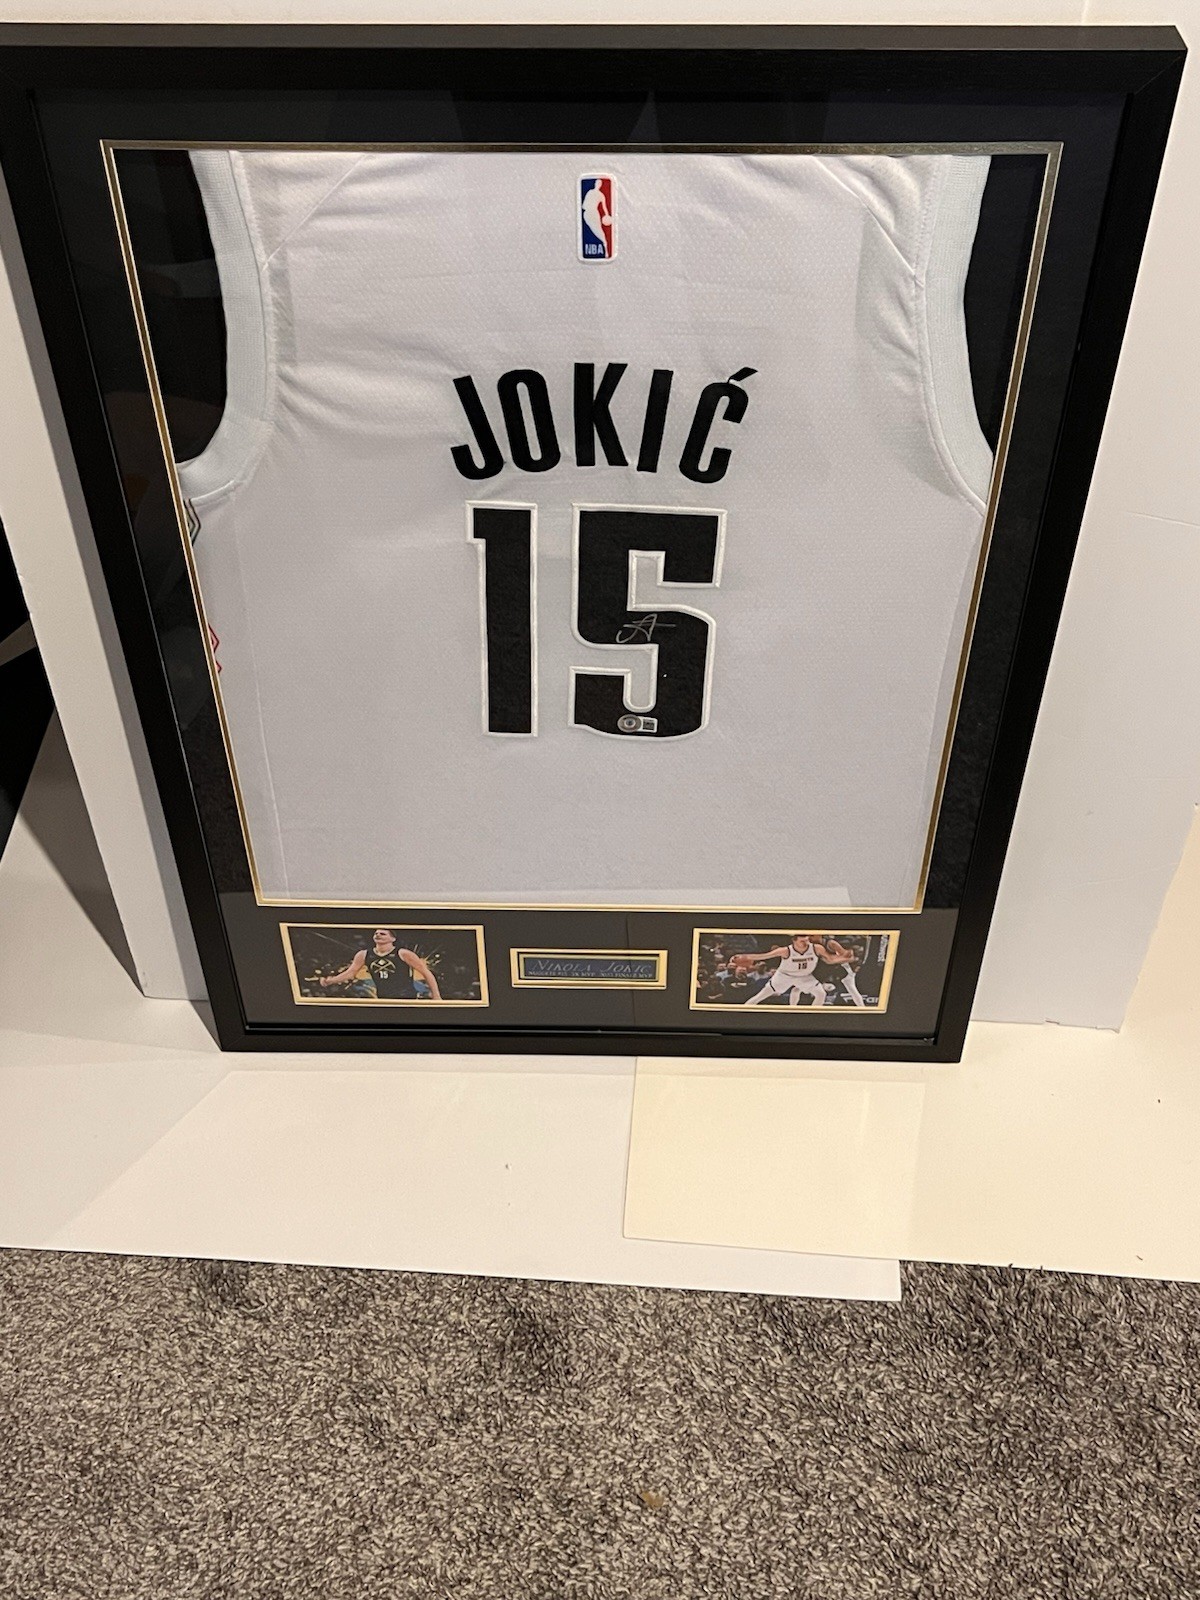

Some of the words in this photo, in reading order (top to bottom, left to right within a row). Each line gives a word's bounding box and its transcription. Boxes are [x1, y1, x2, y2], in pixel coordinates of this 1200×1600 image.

[584, 243, 604, 255] NBA
[450, 362, 758, 484] JOKIĆ
[465, 499, 728, 742] 15
[531, 959, 591, 972] NIKOLA
[600, 961, 652, 973] JOKIC
[798, 962, 808, 970] 15
[379, 970, 389, 979] 15
